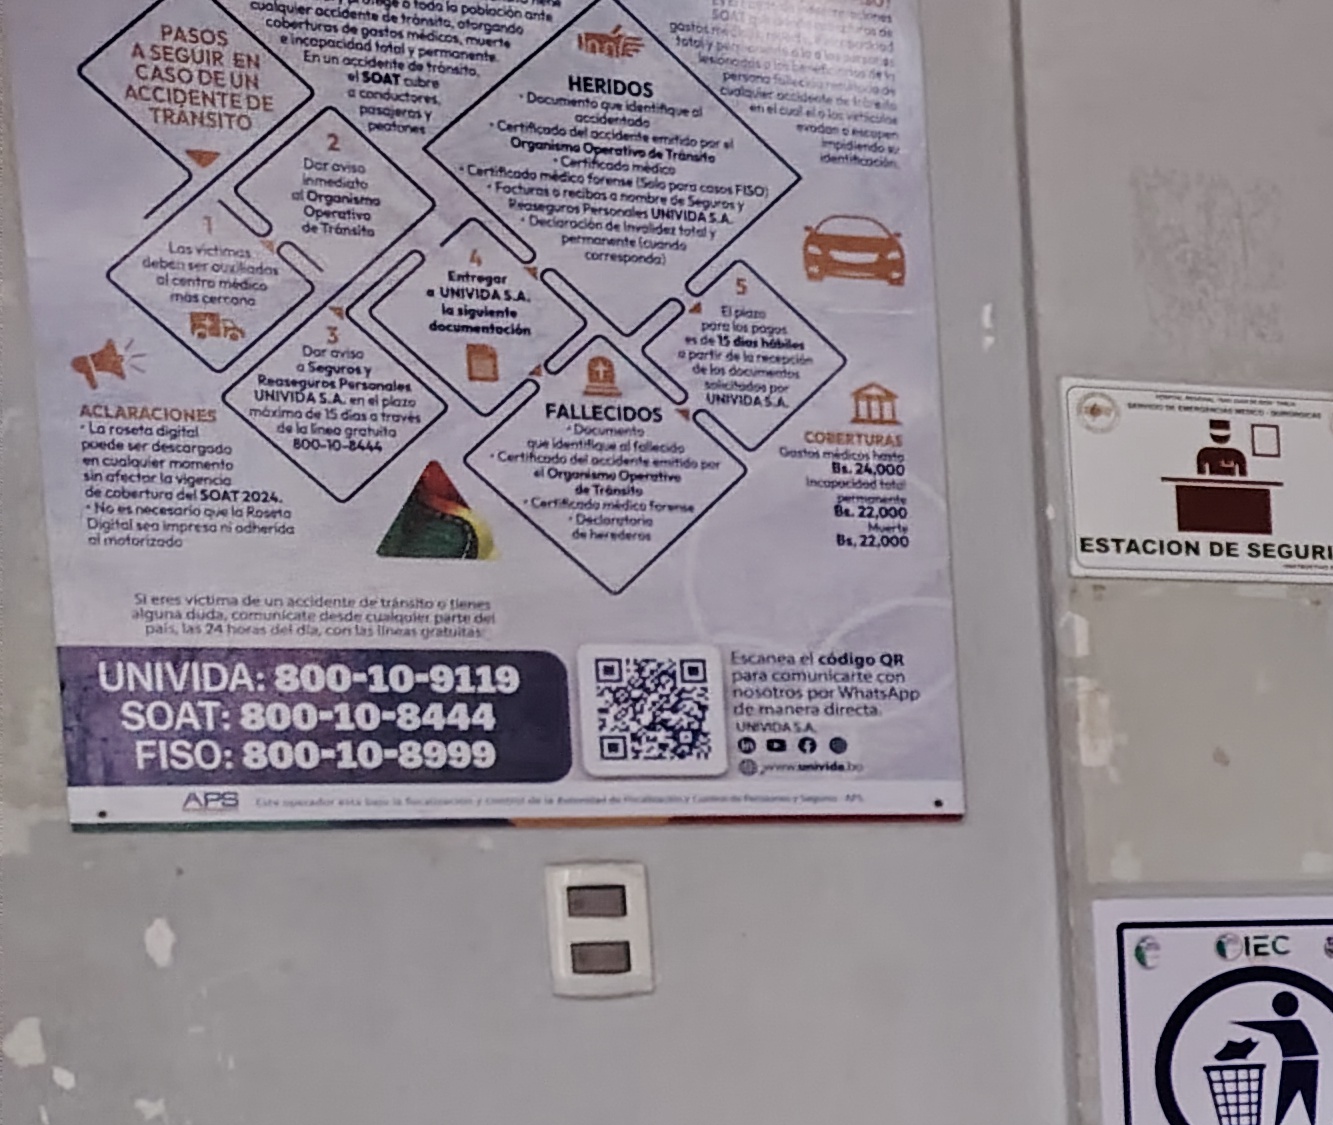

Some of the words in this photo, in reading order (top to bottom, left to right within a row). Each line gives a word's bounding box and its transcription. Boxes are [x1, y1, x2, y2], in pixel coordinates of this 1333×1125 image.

[161, 24, 229, 47] PASOS
[131, 42, 145, 59] A
[150, 45, 224, 66] SEGUIR
[233, 53, 260, 69] EN
[136, 64, 193, 84] CASO
[198, 70, 225, 87] DE
[230, 72, 259, 90] UN
[362, 71, 400, 85] SOAT
[567, 75, 655, 98] HERIDOS
[125, 85, 242, 110] ACCIDENTE
[247, 95, 274, 112] DE
[79, 404, 218, 424] ACLARACIONES
[545, 402, 664, 423] FALLECIDOS
[293, 438, 383, 453] 800-10-8444
[804, 431, 903, 448] COBERTURAS
[832, 461, 853, 475] Bs.
[200, 489, 239, 502] SOAT
[834, 504, 855, 518] Bs.
[1080, 536, 1200, 557] ESTACION
[1209, 540, 1240, 558] DE
[731, 652, 796, 666] Escanea
[800, 652, 814, 666] el
[818, 651, 876, 669] código
[880, 653, 905, 669] QR
[98, 660, 266, 693] UNIVIDA:
[274, 663, 521, 695] 800-10-9119
[732, 671, 768, 684] para
[772, 669, 873, 683] comunicarte
[877, 671, 905, 684] con
[733, 686, 803, 699] nosotros
[807, 689, 834, 701] por
[838, 686, 921, 702] WhatsApp
[120, 699, 231, 731] SOAT:
[240, 701, 497, 732] 800-10-8444
[733, 703, 755, 716] de
[759, 704, 820, 716] manera
[135, 740, 234, 770] FISO:
[242, 740, 497, 771] 800-10-8999
[1244, 935, 1290, 957] IEC
